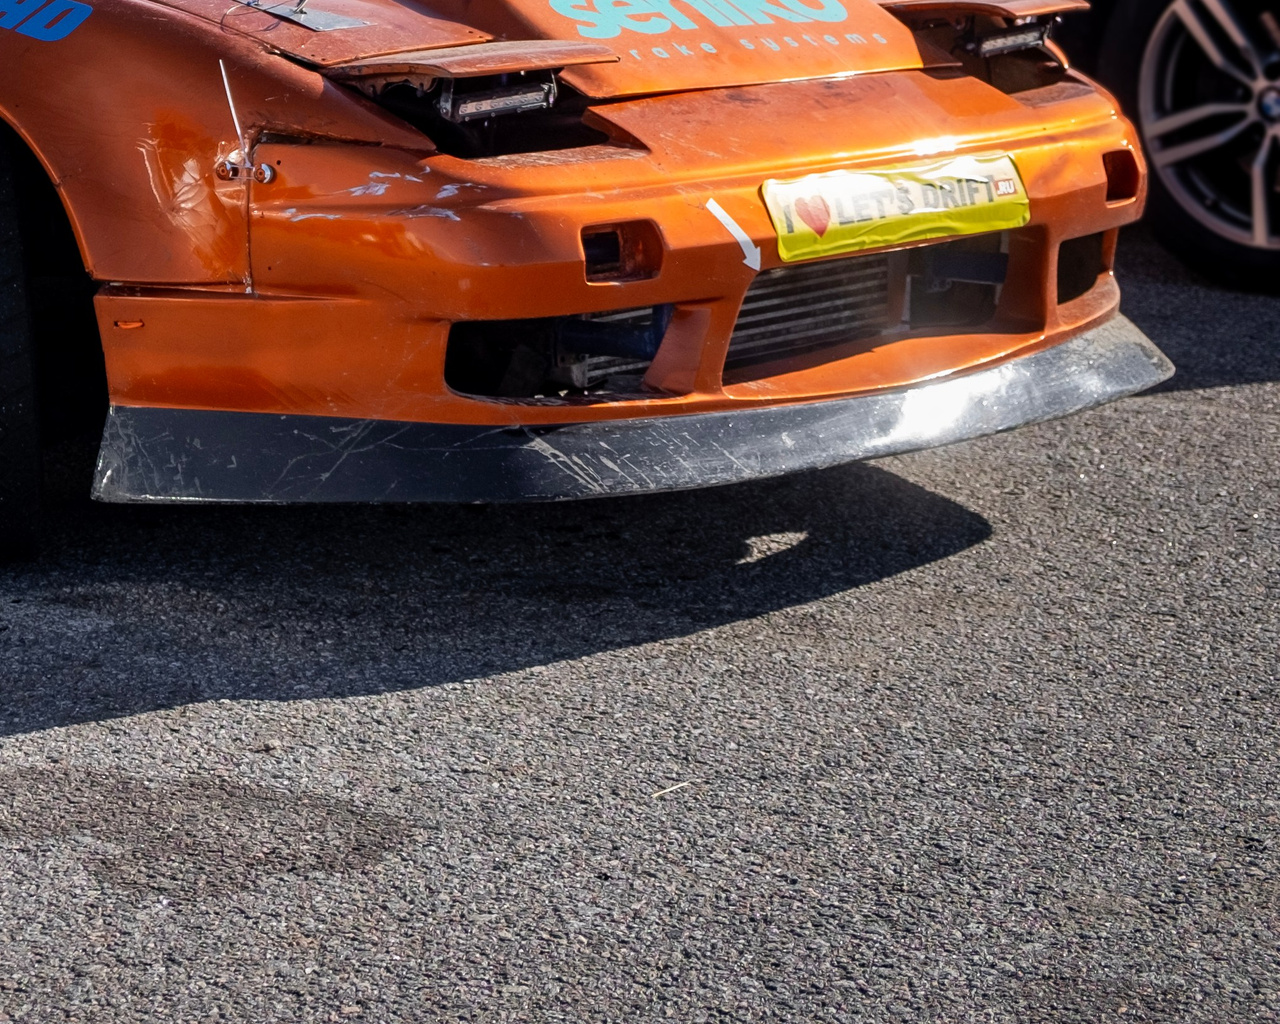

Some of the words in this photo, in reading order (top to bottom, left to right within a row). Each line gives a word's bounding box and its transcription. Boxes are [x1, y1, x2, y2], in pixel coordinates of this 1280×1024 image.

[739, 32, 888, 52] systems
[783, 204, 795, 234] I
[835, 185, 916, 226] LET'S
